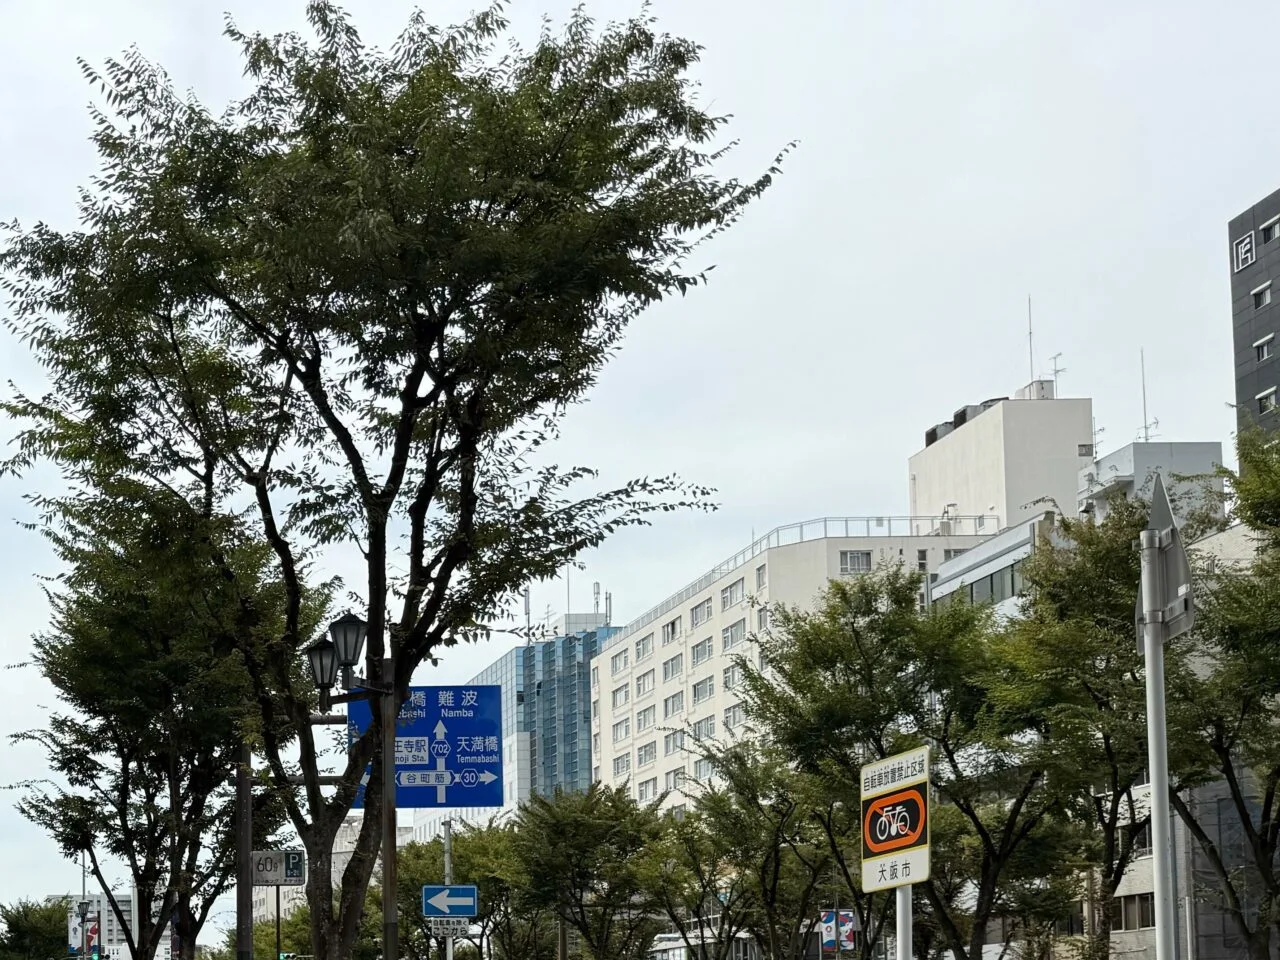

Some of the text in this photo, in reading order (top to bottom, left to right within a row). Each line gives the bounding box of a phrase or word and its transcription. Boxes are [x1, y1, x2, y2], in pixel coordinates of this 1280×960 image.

[438, 690, 478, 707] 難波
[441, 708, 474, 717] Namba
[395, 736, 498, 754] 王寺駅 702 天満橋
[456, 754, 500, 764] Temmabashi
[406, 773, 476, 784] 谷町筋 30
[289, 854, 299, 868] P
[878, 862, 911, 882] 大阪市
[433, 927, 468, 936] ここから
